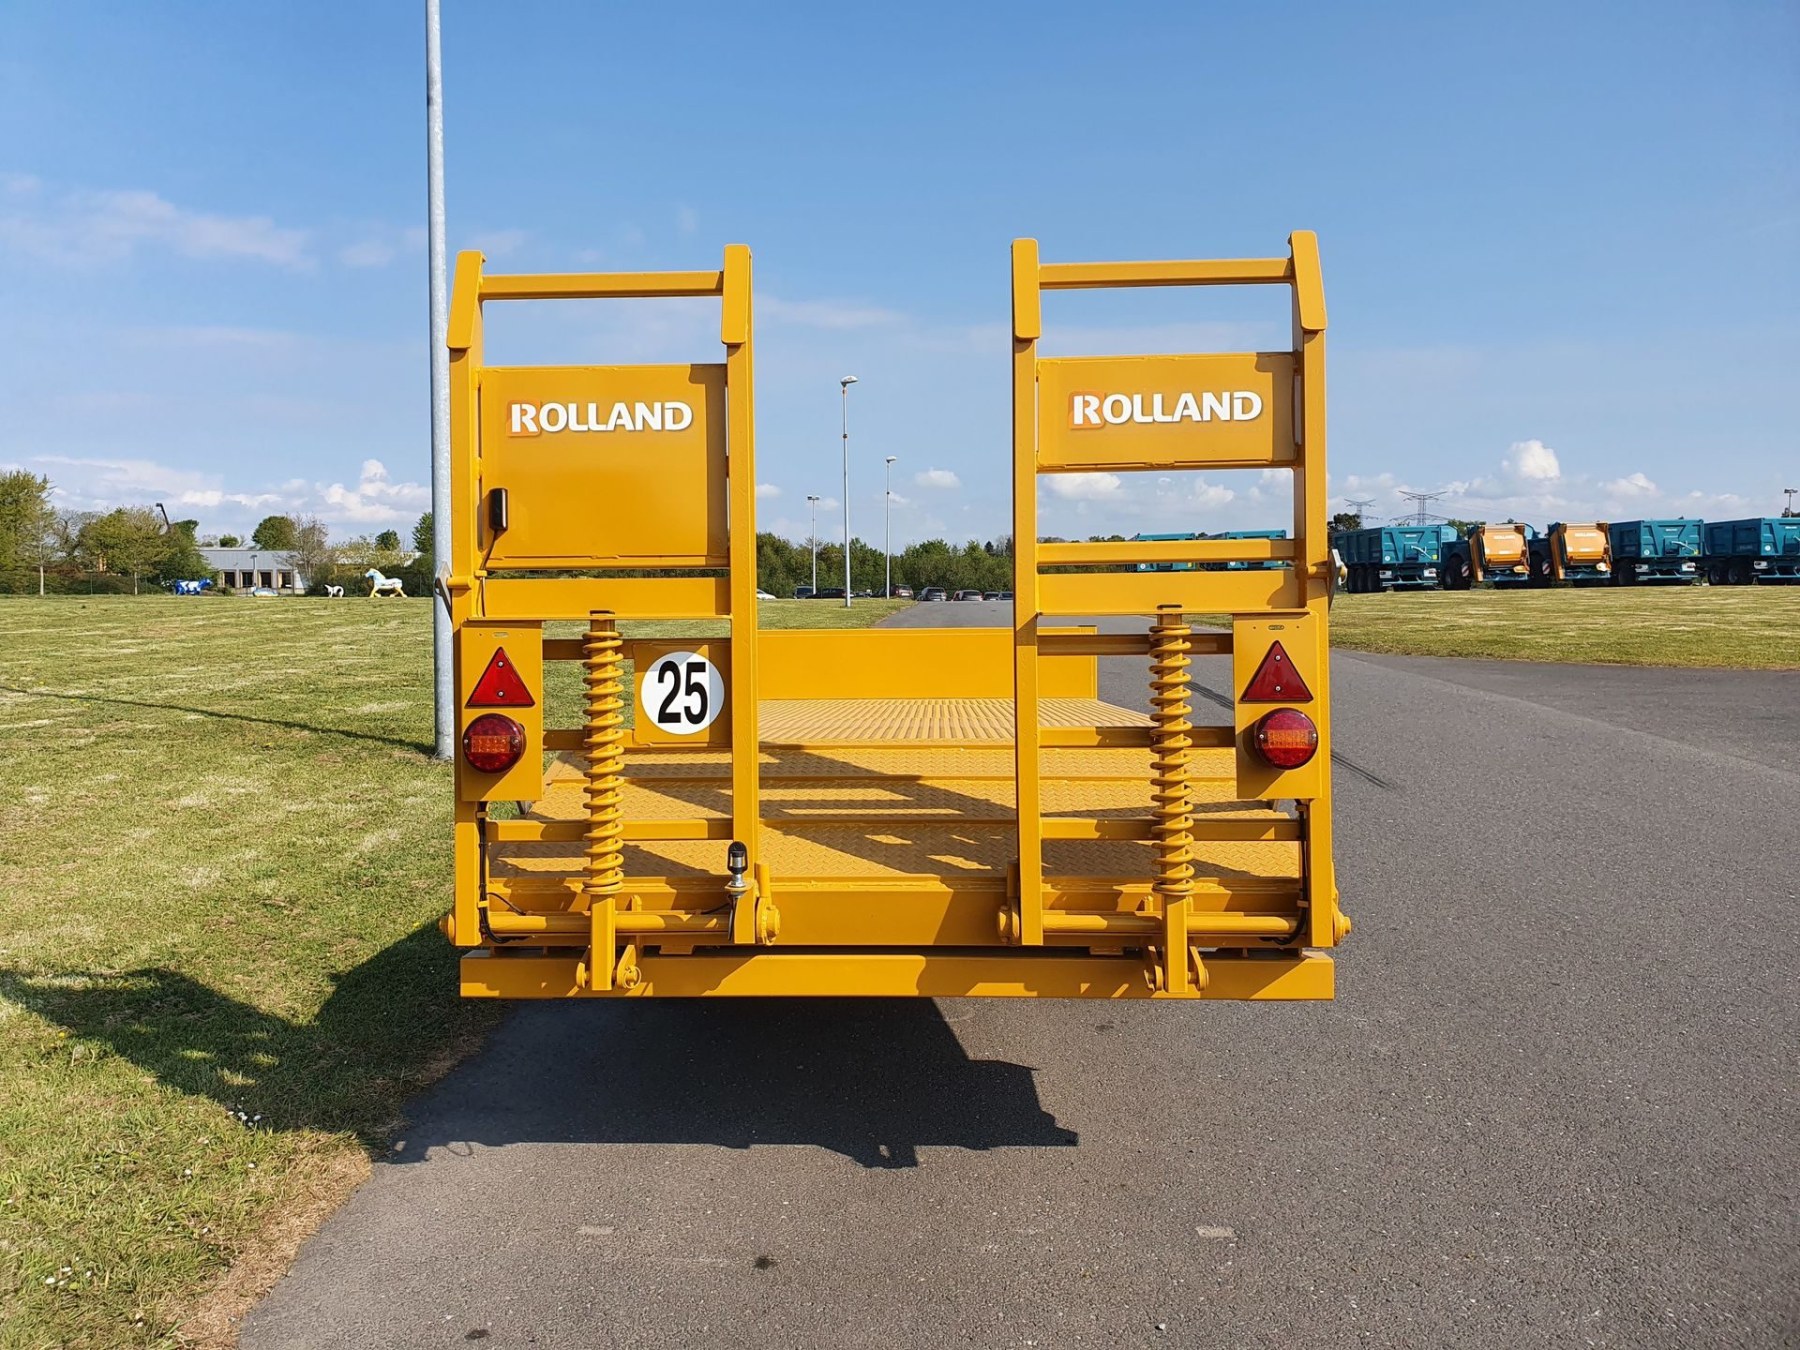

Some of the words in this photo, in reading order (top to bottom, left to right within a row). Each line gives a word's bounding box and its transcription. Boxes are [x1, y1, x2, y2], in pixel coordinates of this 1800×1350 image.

[510, 401, 693, 433] ROLLAND
[1073, 390, 1263, 426] ROLLAND
[657, 660, 708, 725] 25
